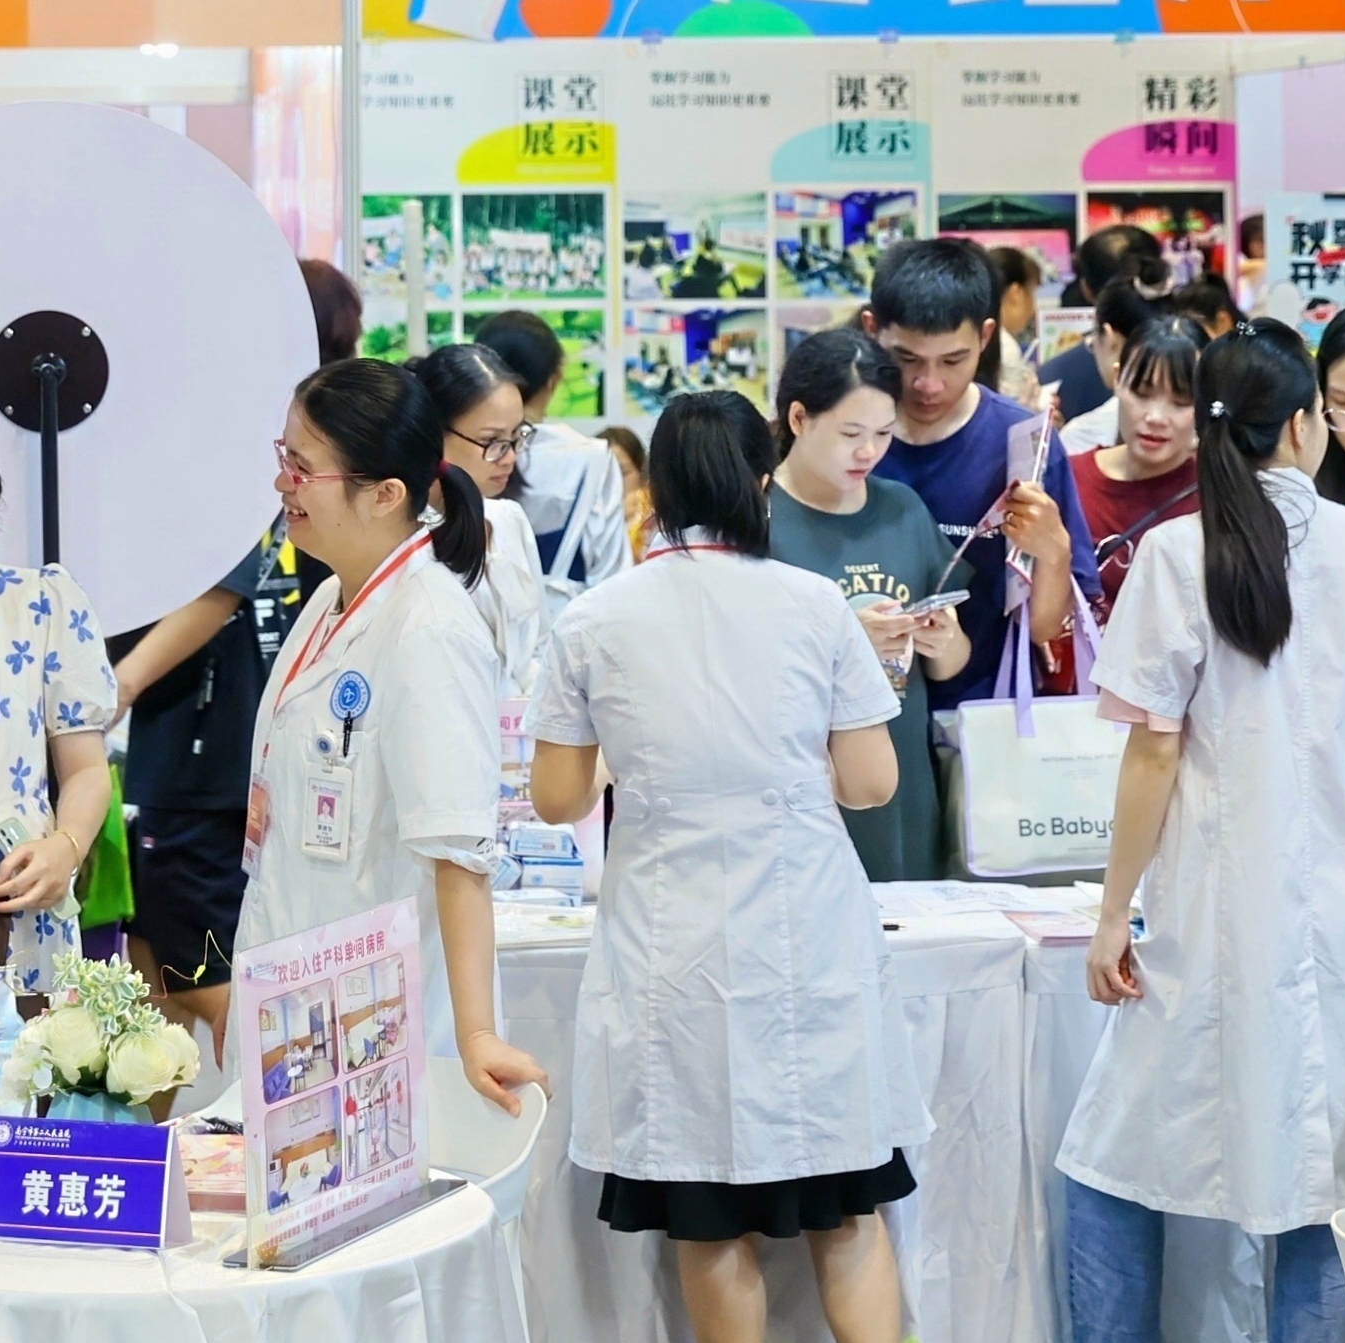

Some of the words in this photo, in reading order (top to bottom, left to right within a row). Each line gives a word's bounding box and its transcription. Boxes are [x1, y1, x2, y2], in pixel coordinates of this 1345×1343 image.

[523, 74, 598, 113] 课堂
[836, 73, 909, 111] 课堂
[1143, 74, 1219, 112] 精彩
[523, 121, 600, 157] 展示
[836, 120, 912, 155] 展示
[1143, 120, 1219, 156] 瞬间
[1018, 819, 1046, 837] Bc
[21, 1169, 126, 1219] 黄惠芳
